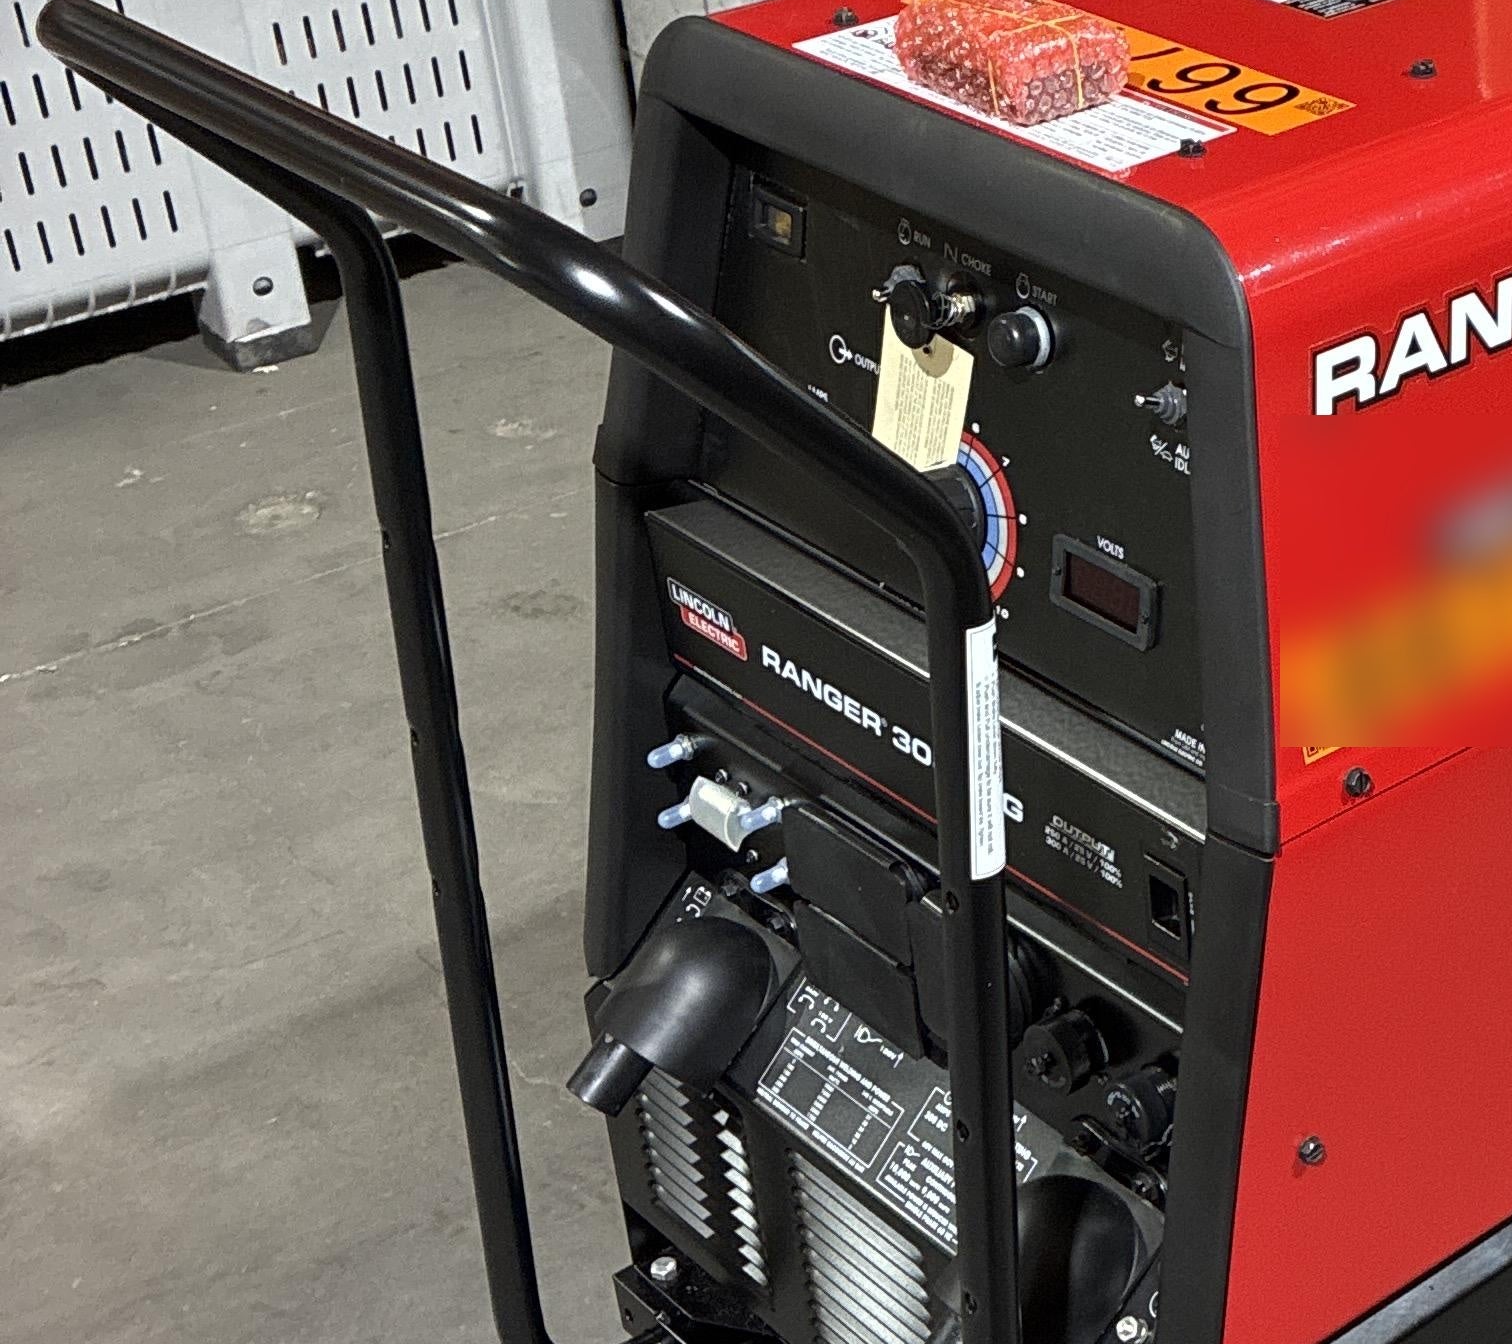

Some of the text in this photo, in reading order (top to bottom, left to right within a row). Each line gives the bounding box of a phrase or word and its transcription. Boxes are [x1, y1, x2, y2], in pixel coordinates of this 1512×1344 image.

[914, 230, 931, 249] RUN
[961, 253, 992, 277] CHOKE
[1032, 285, 1058, 306] START
[854, 353, 881, 376] OUTPU
[1174, 457, 1191, 475] IDL
[1096, 535, 1125, 560] VOLTS
[670, 583, 731, 632] LINCOLN
[688, 611, 740, 653] ELECTRIC
[761, 644, 882, 737] RANGER
[891, 725, 933, 768] 30
[1174, 728, 1198, 749] MADE
